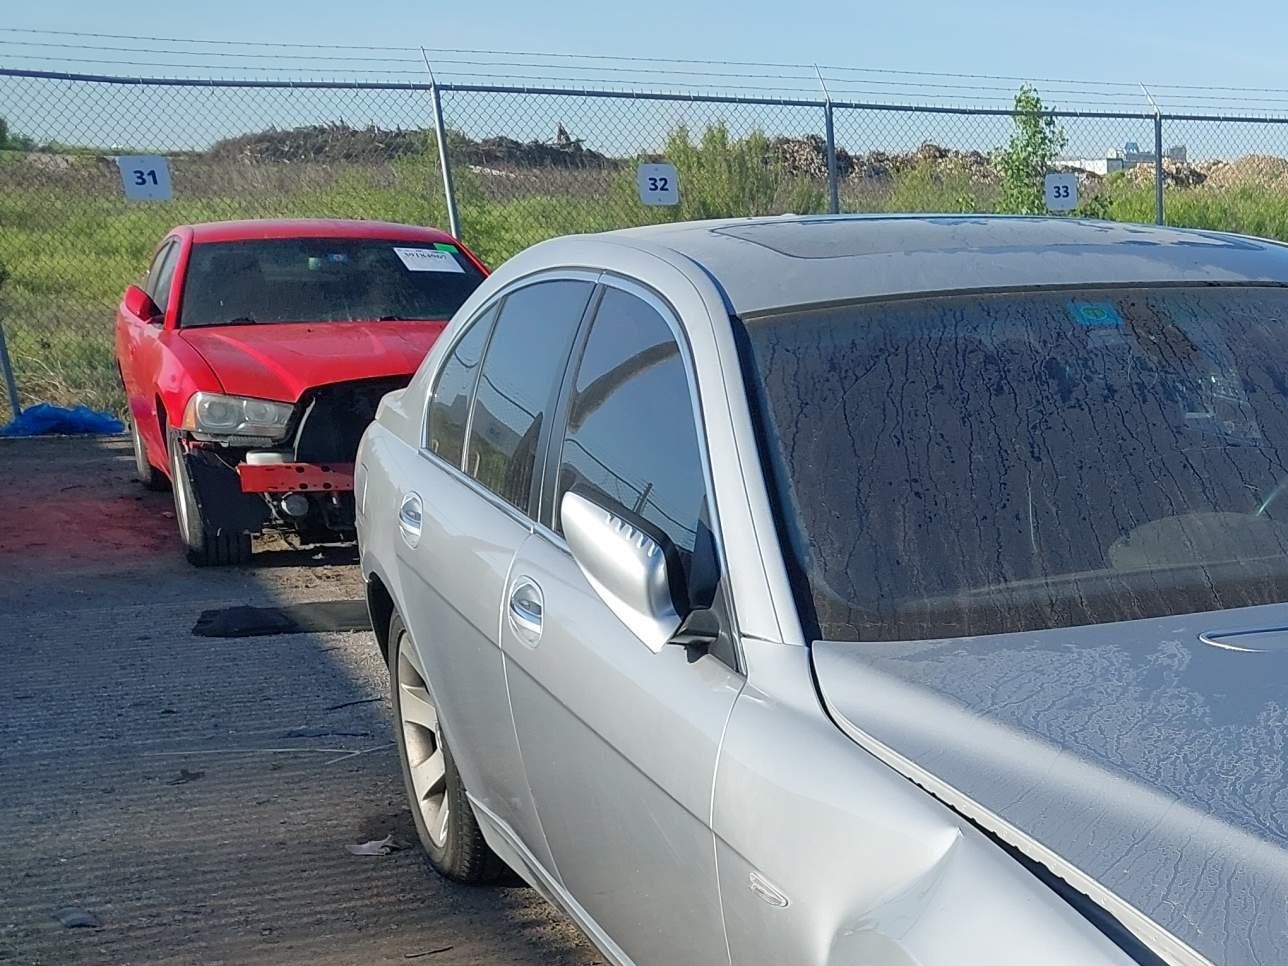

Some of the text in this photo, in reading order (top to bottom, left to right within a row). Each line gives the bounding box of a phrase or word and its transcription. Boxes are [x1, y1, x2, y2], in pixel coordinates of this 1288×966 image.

[133, 169, 158, 186] 31
[648, 177, 669, 192] 32
[1053, 185, 1070, 199] 33
